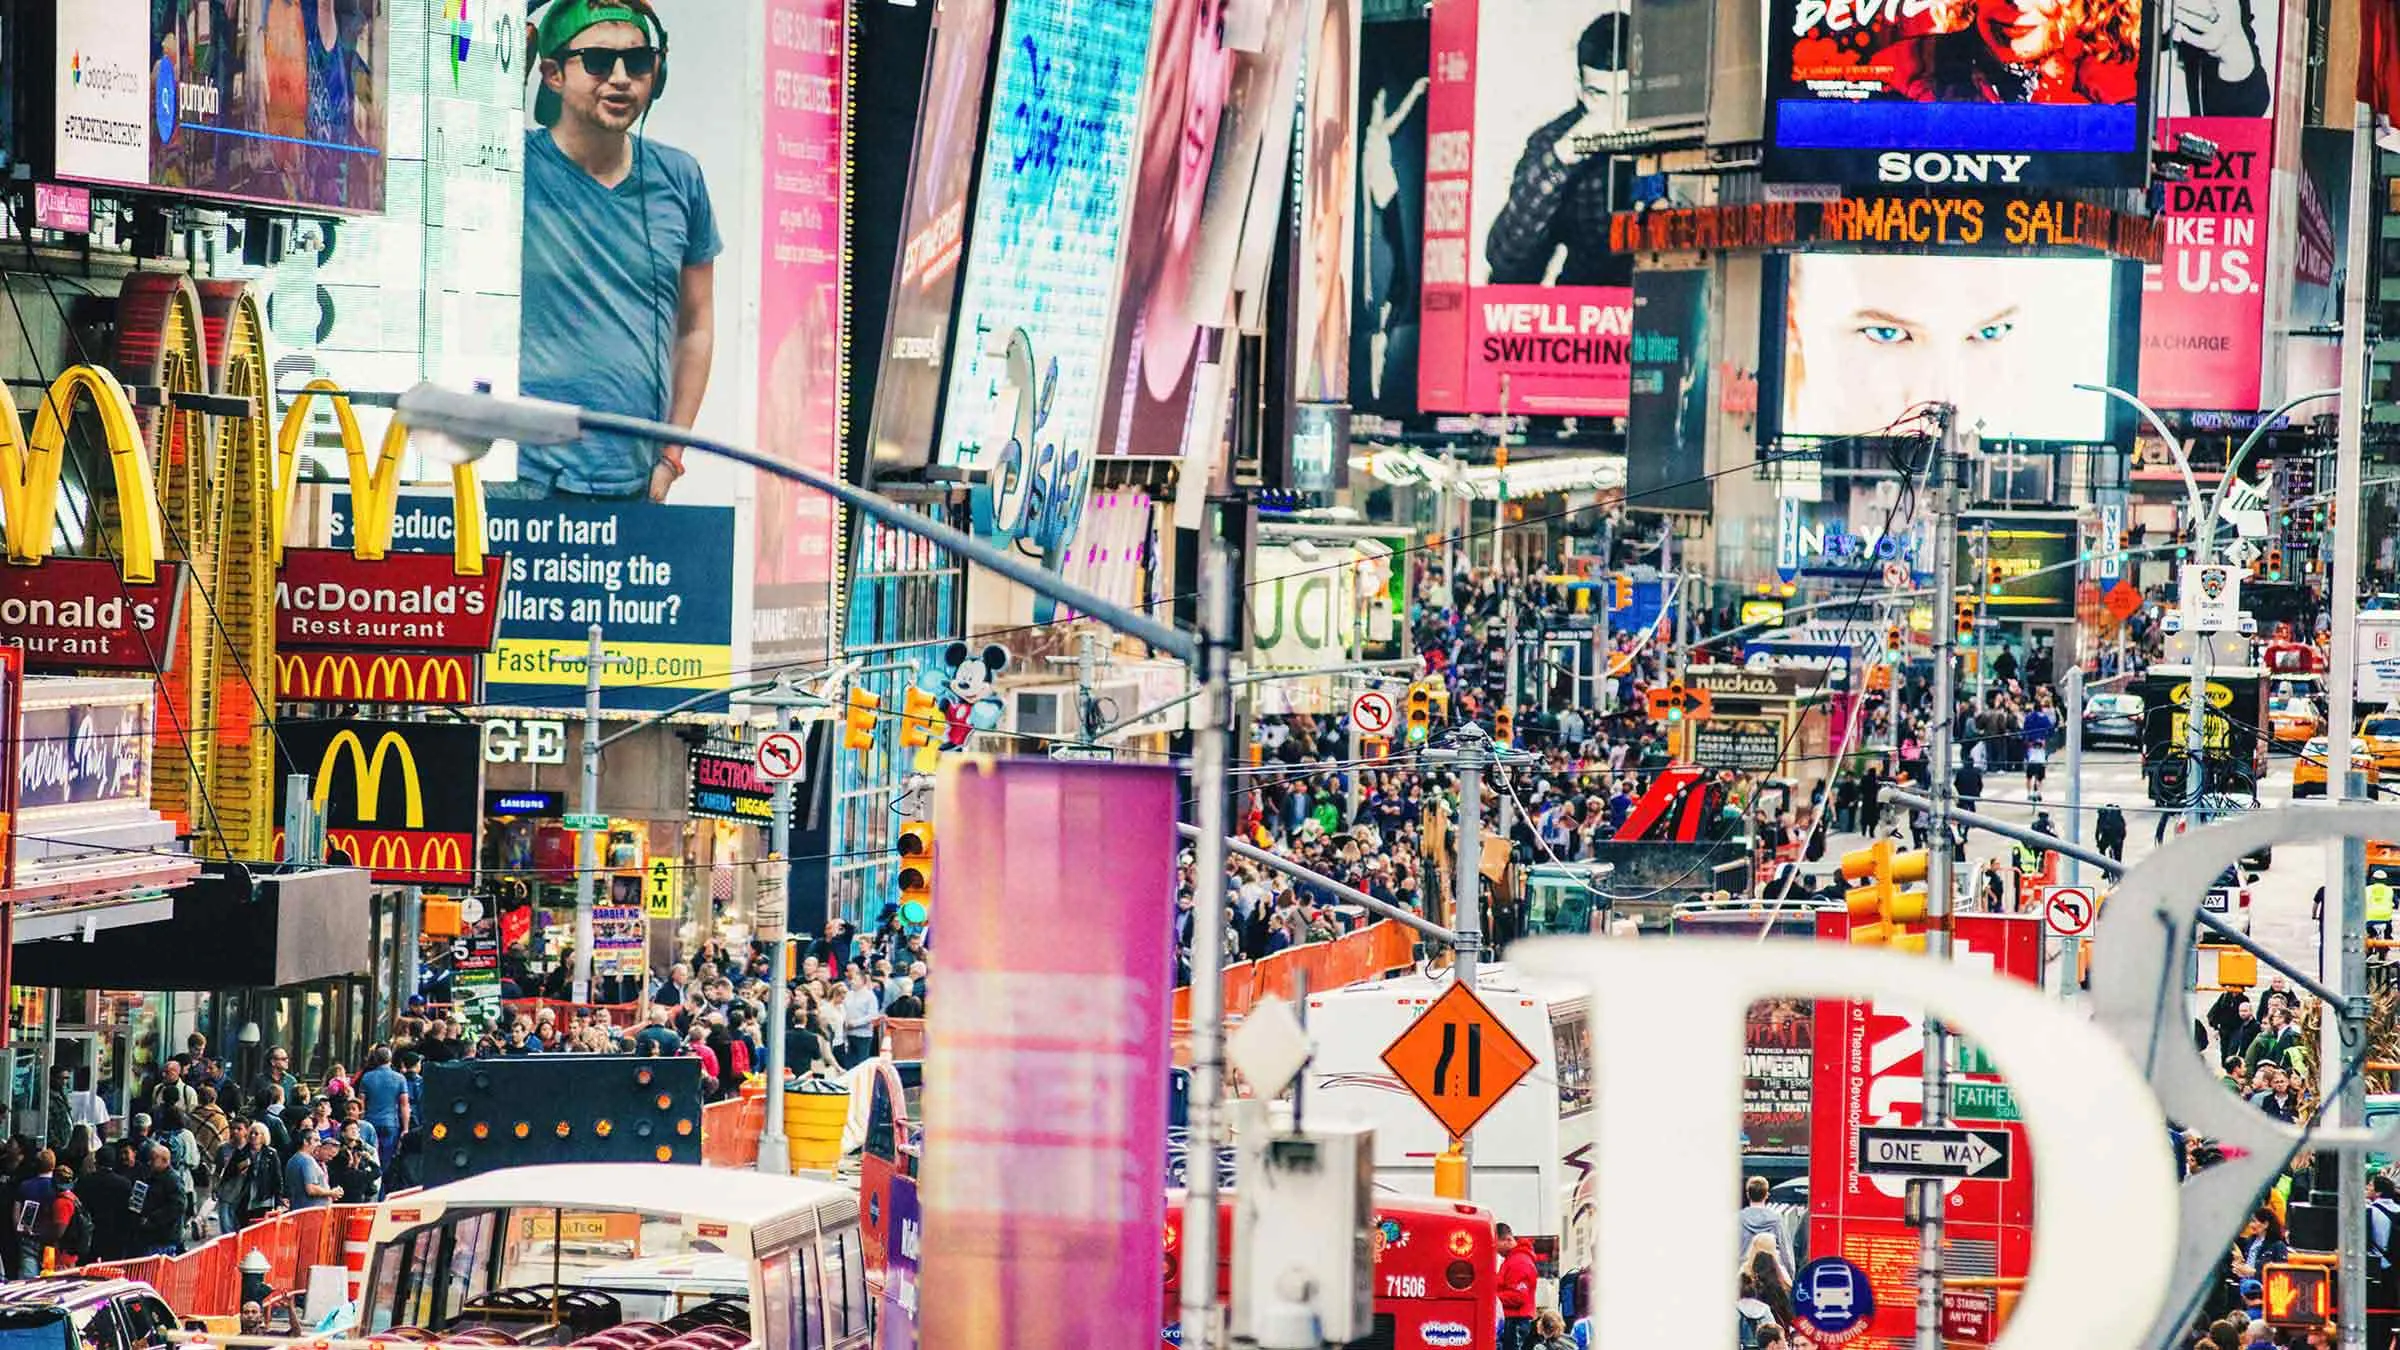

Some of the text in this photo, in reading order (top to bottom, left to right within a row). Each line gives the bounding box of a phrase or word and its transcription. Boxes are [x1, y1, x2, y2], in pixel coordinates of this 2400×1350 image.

[179, 76, 219, 121] pumpkin
[1878, 152, 2031, 184] SONY
[2193, 151, 2257, 180] EXT
[2174, 186, 2254, 213] DATA
[2167, 217, 2216, 246] IKE
[2224, 218, 2255, 246] IN
[2178, 250, 2260, 294] U.S.
[1483, 303, 1634, 336] WE'LL PAY
[2163, 336, 2231, 351] CHARGE
[526, 514, 553, 543] or
[558, 513, 617, 545] hard
[533, 552, 622, 591] raising
[627, 554, 672, 586] the
[276, 581, 485, 614] McDonald's
[501, 590, 682, 625] llars an hour?
[0, 596, 155, 630] onald's
[292, 617, 446, 637] Restaurant
[497, 647, 703, 680] FastFooFlop.com
[1696, 674, 1778, 693] nuchas
[485, 718, 564, 763] GE
[500, 799, 544, 809] SAMSUNG
[698, 792, 731, 812] CAMERA
[652, 862, 668, 908] ATM
[451, 939, 469, 960] 5
[1851, 1024, 1864, 1073] Theatre
[1880, 1142, 1986, 1164] ONE WAY
[1386, 1273, 1426, 1298] 71506
[1944, 1296, 1988, 1311] NO STANDING
[1950, 1311, 1984, 1325] ANYTIME
[1800, 1317, 1869, 1345] NO STANDING
